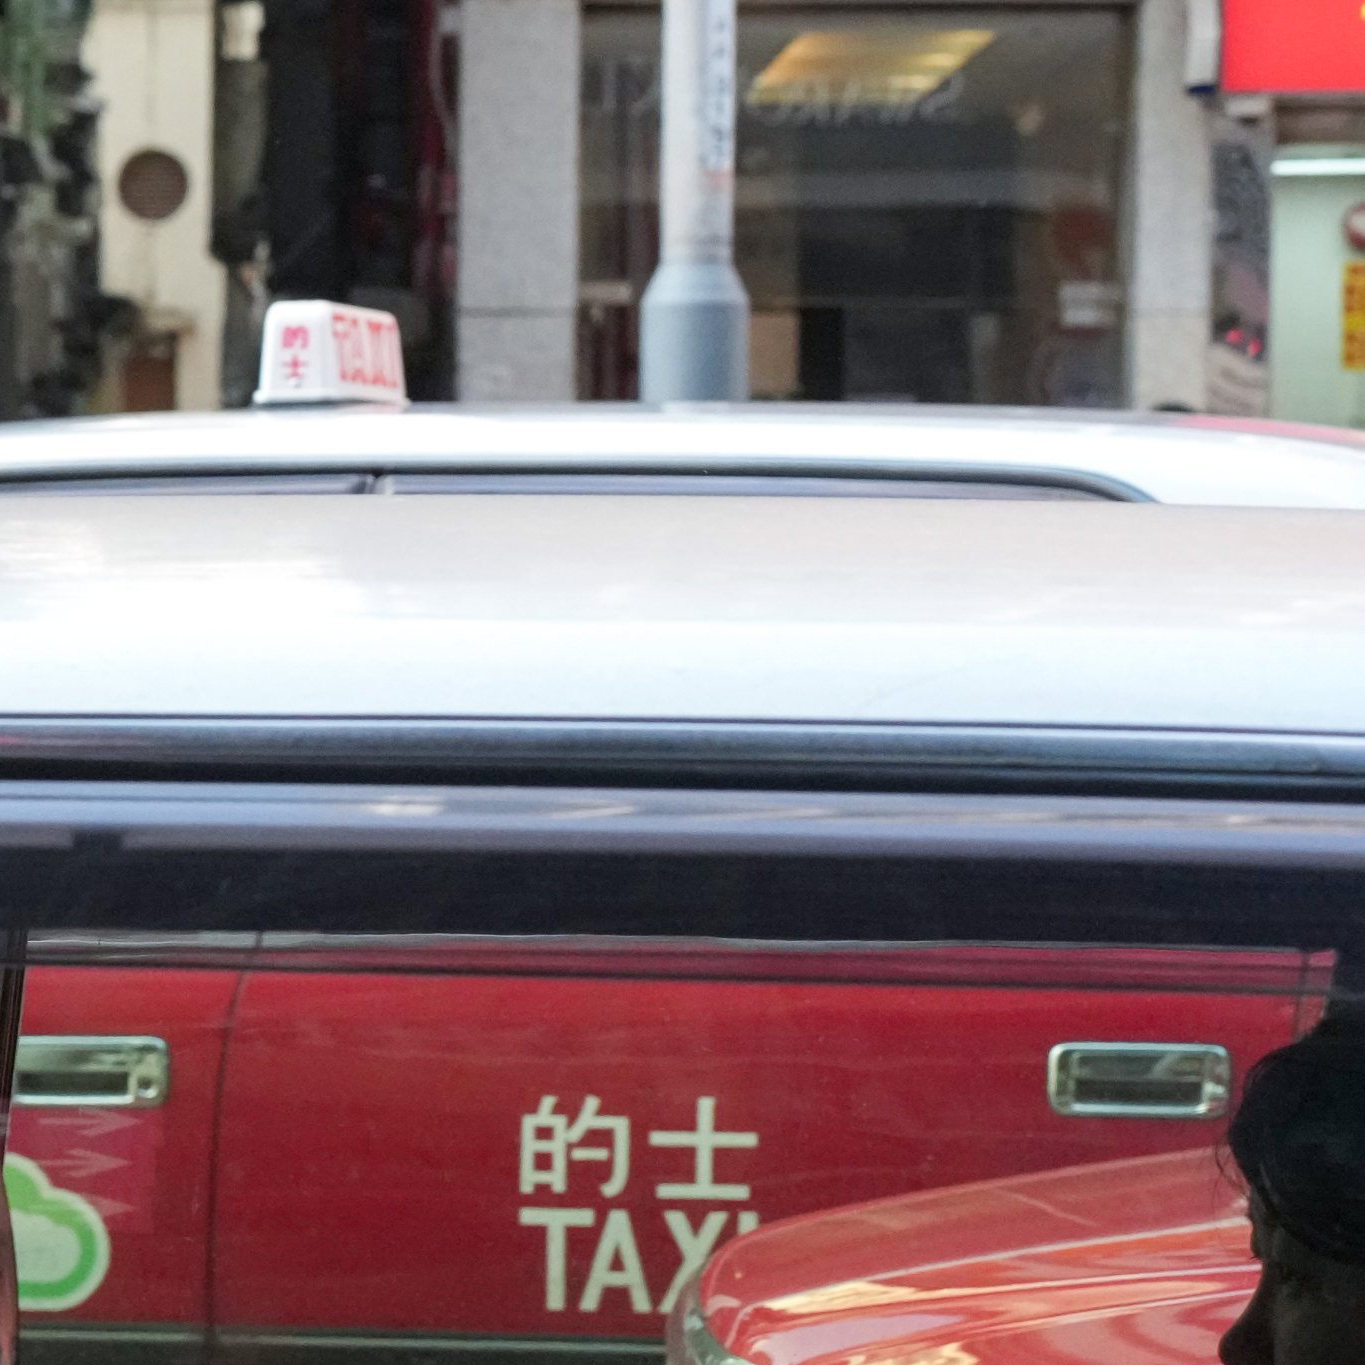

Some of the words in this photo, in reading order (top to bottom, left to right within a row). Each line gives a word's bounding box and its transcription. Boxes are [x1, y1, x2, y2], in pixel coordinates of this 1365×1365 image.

[332, 313, 399, 389] TAXI
[519, 1095, 759, 1199] 的士
[519, 1207, 760, 1314] TAX
